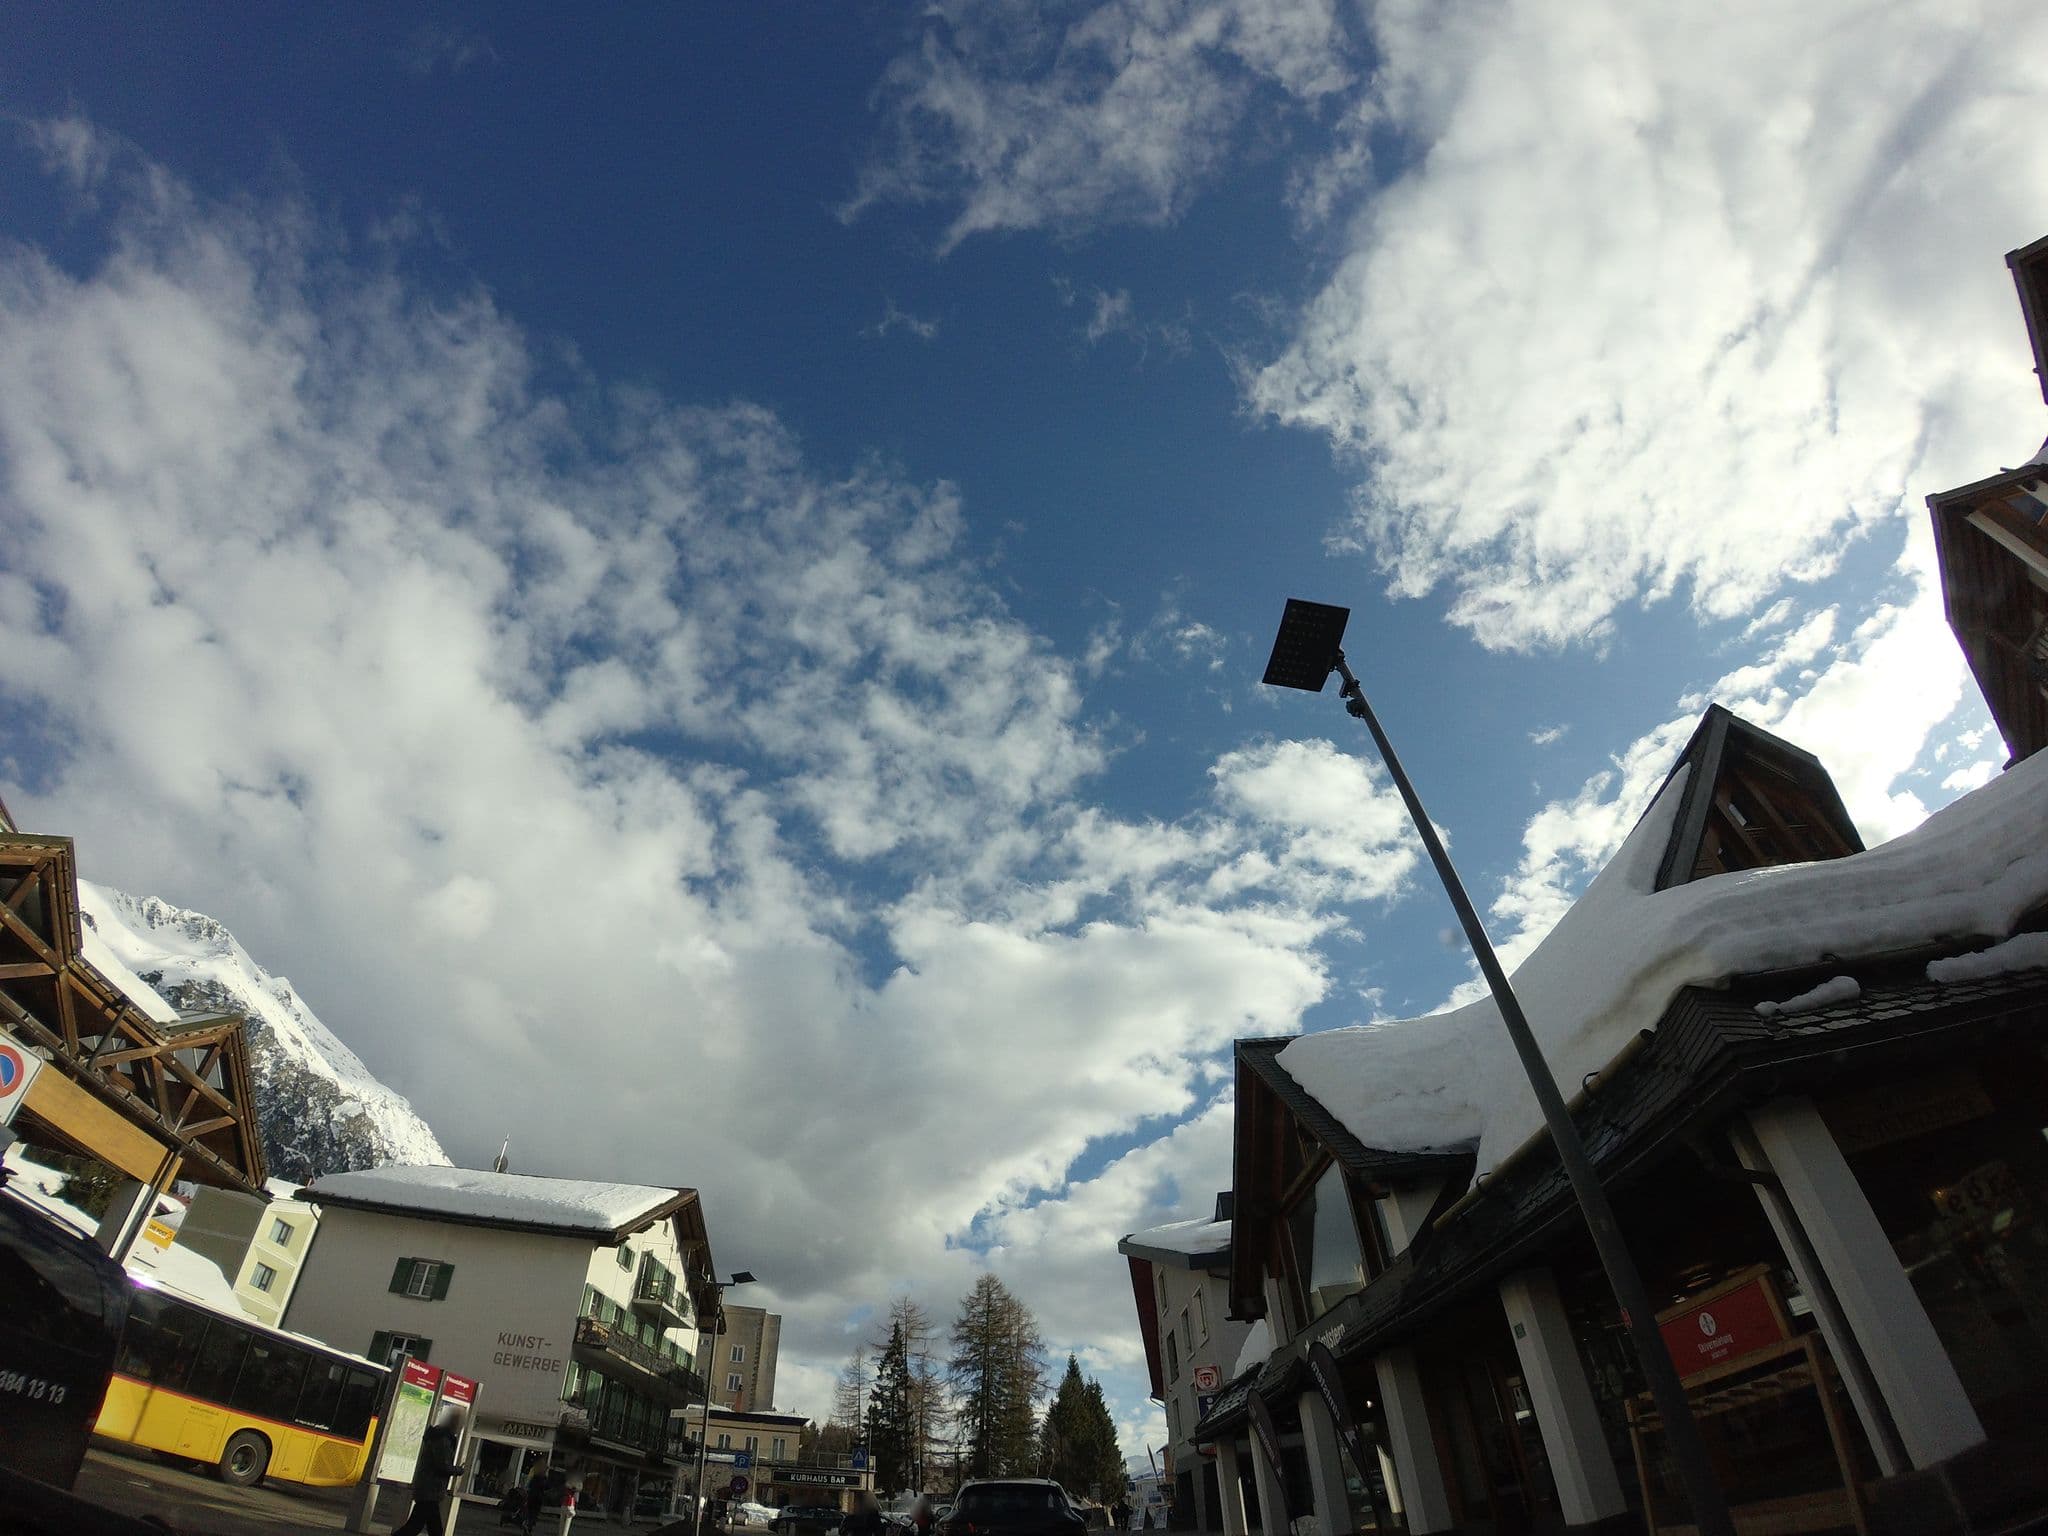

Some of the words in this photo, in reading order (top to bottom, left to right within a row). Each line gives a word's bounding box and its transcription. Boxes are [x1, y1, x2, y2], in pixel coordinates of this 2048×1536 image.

[497, 1332, 552, 1349] KUNST-
[493, 1351, 561, 1373] GEWERBE
[27, 1378, 46, 1399] 13
[48, 1384, 66, 1405] 13
[790, 1473, 828, 1483] KURHAUS
[830, 1475, 846, 1484] BAR
